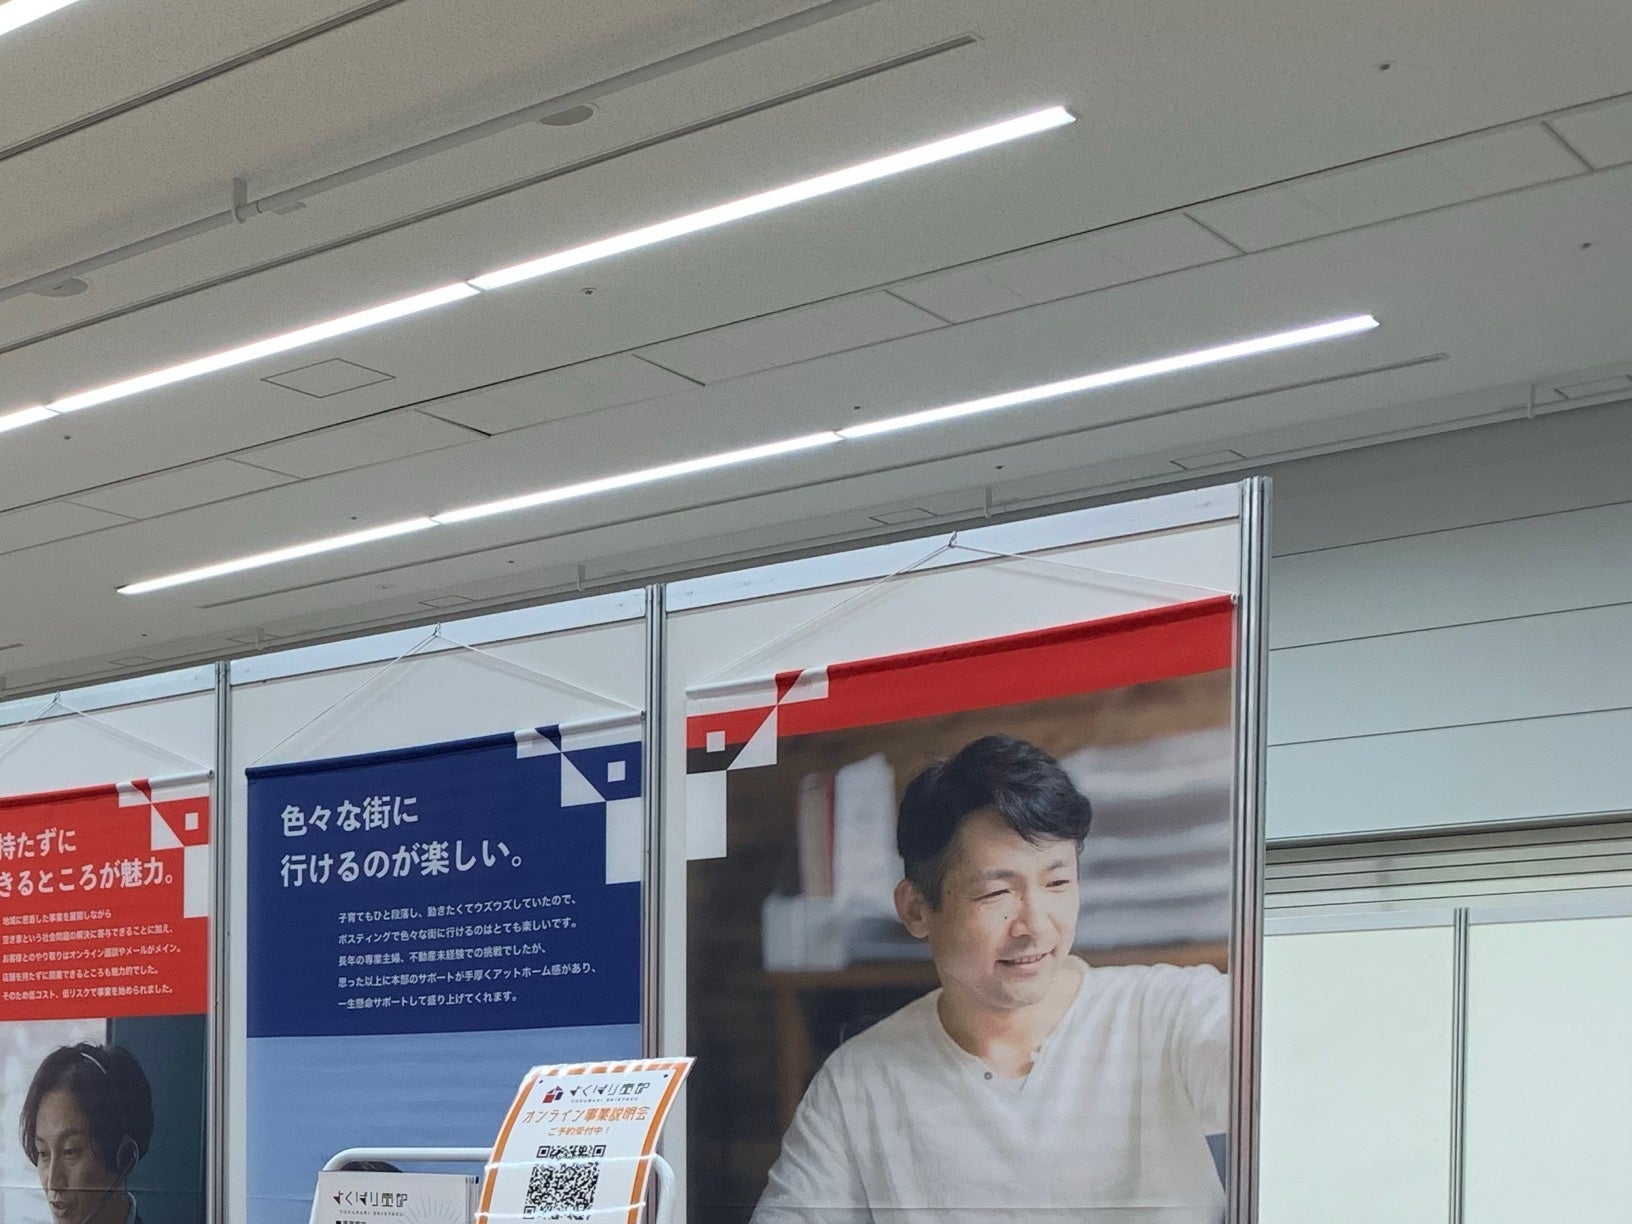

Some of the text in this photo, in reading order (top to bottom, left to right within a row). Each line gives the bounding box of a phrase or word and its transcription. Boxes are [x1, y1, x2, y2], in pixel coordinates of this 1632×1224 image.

[281, 796, 418, 837] 色々な街に
[281, 838, 522, 887] 行けるのが楽しい。
[338, 894, 576, 923] 子育てもひと段落し、動きたくてウズウズしていたので、
[338, 917, 576, 945] ポスティングで色々な街に行けるのはとても楽しいです。
[338, 943, 546, 967] 長年の専業主婦、不動産未経験での挑戦でしたが、
[338, 962, 596, 988] 思った以上に本部のサポートが手厚くアットホーム感があり、
[338, 991, 517, 1009] 一生懸命サポートして盛り上げてくれます。
[570, 1083, 651, 1097] よくばり売却
[523, 1106, 650, 1123] オンライン事業説明会
[548, 1127, 609, 1136] ご予約受付中！
